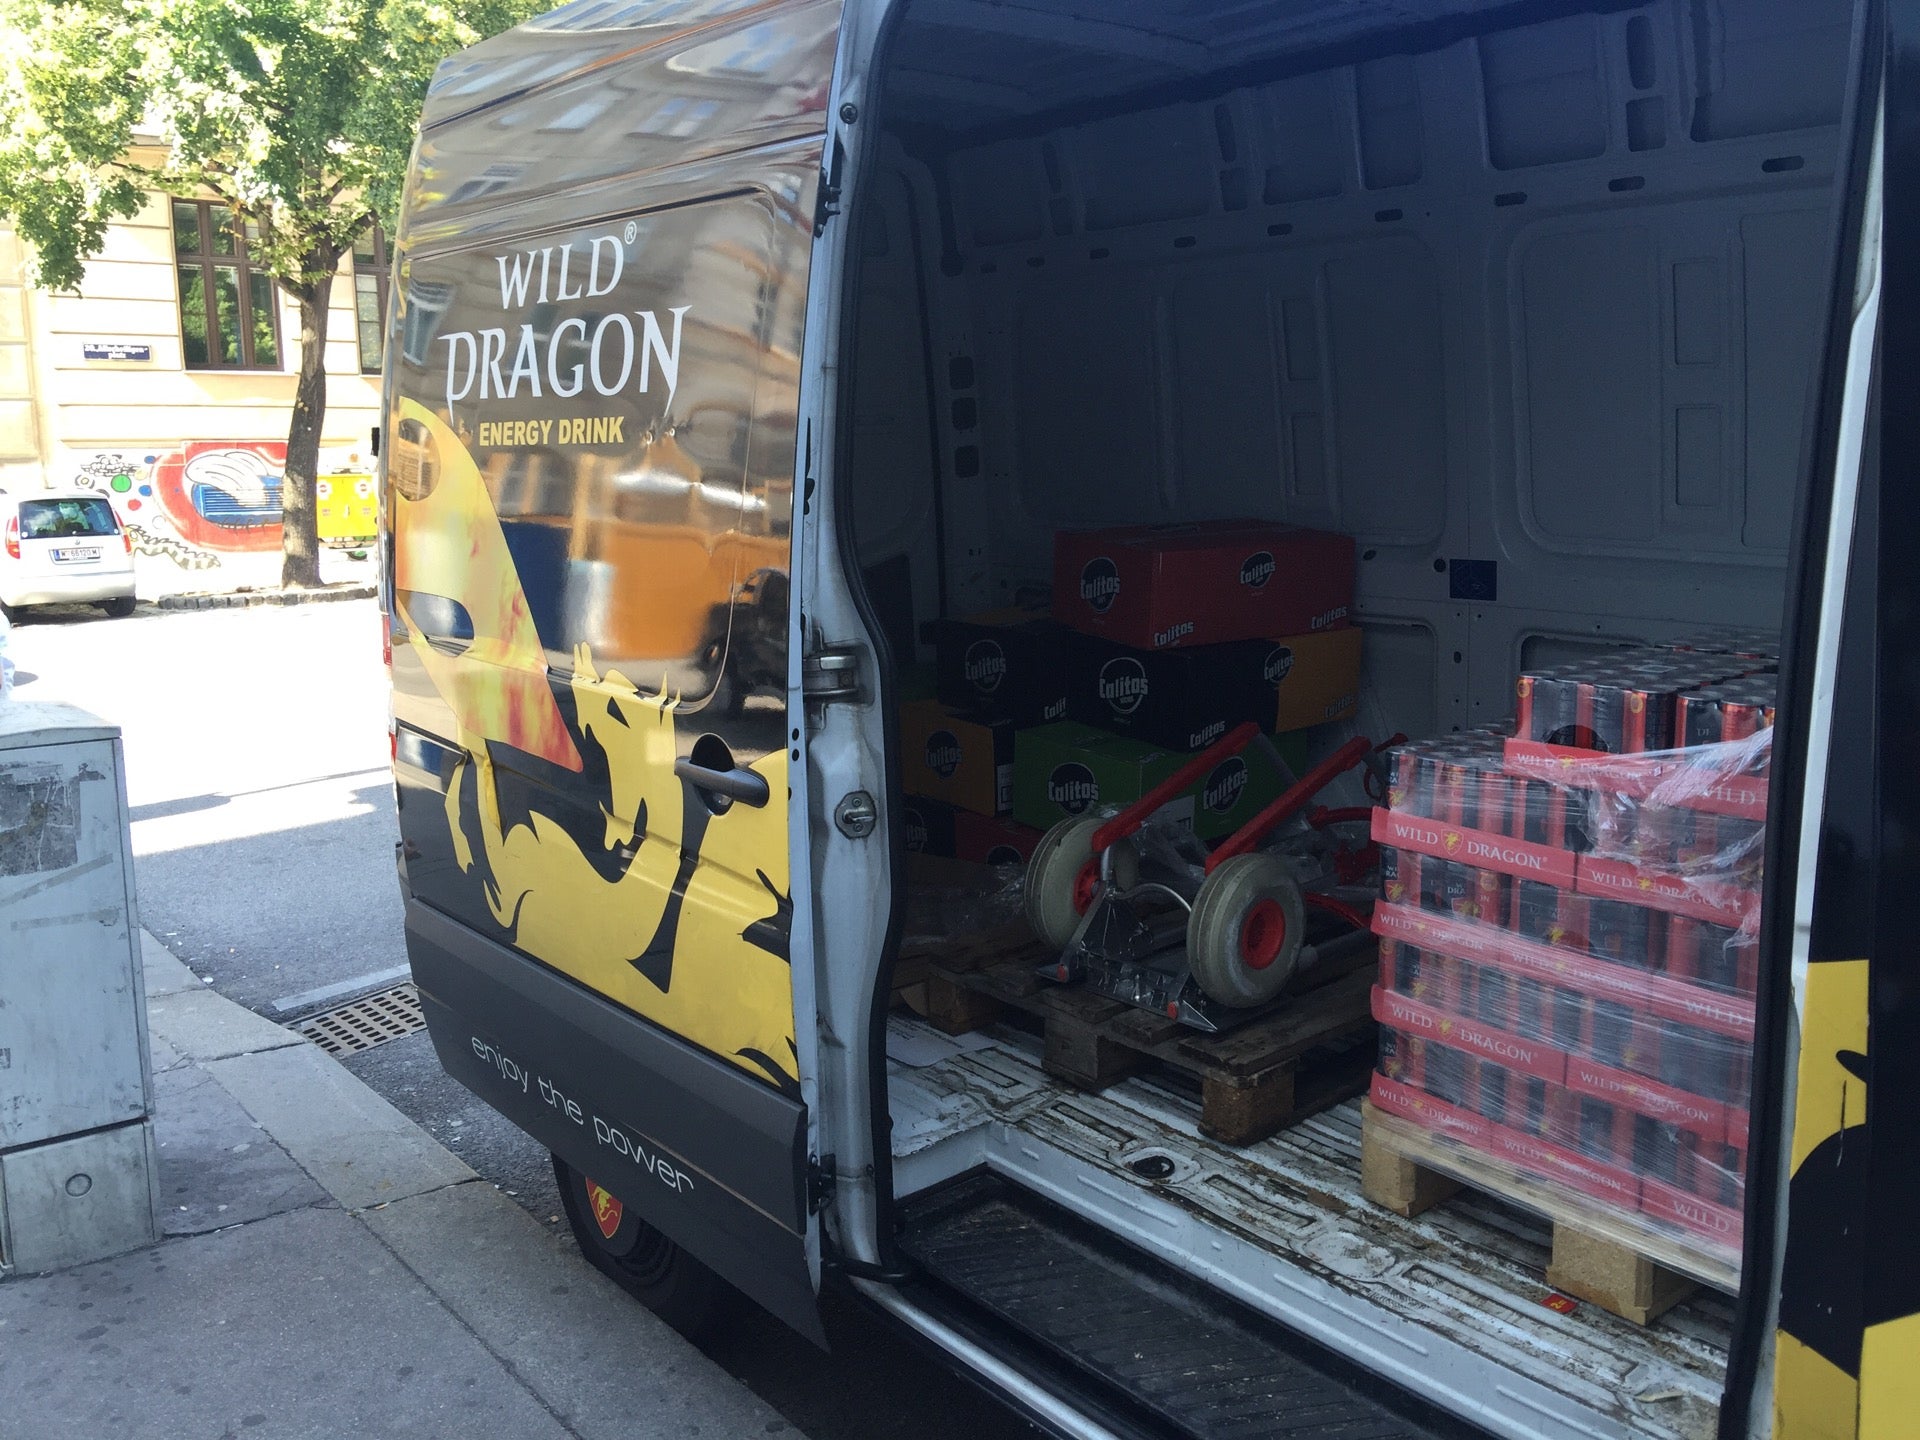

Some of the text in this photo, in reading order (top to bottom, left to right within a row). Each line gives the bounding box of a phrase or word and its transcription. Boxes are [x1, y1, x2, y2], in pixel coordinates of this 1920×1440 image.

[437, 305, 693, 427] DRAGON
[479, 416, 624, 446] ENERGY DRINK
[1394, 824, 1439, 845] WILD
[1591, 870, 1633, 888] WILD
[1379, 913, 1412, 930] WILD
[1391, 1003, 1432, 1028] WILD
[1685, 1000, 1742, 1025] WILD
[1580, 1070, 1621, 1092] WILD
[1378, 1087, 1410, 1107] WILD
[471, 1036, 695, 1193] enjoy the power
[1503, 1139, 1542, 1160] WILD
[1672, 1201, 1731, 1234] WILD
